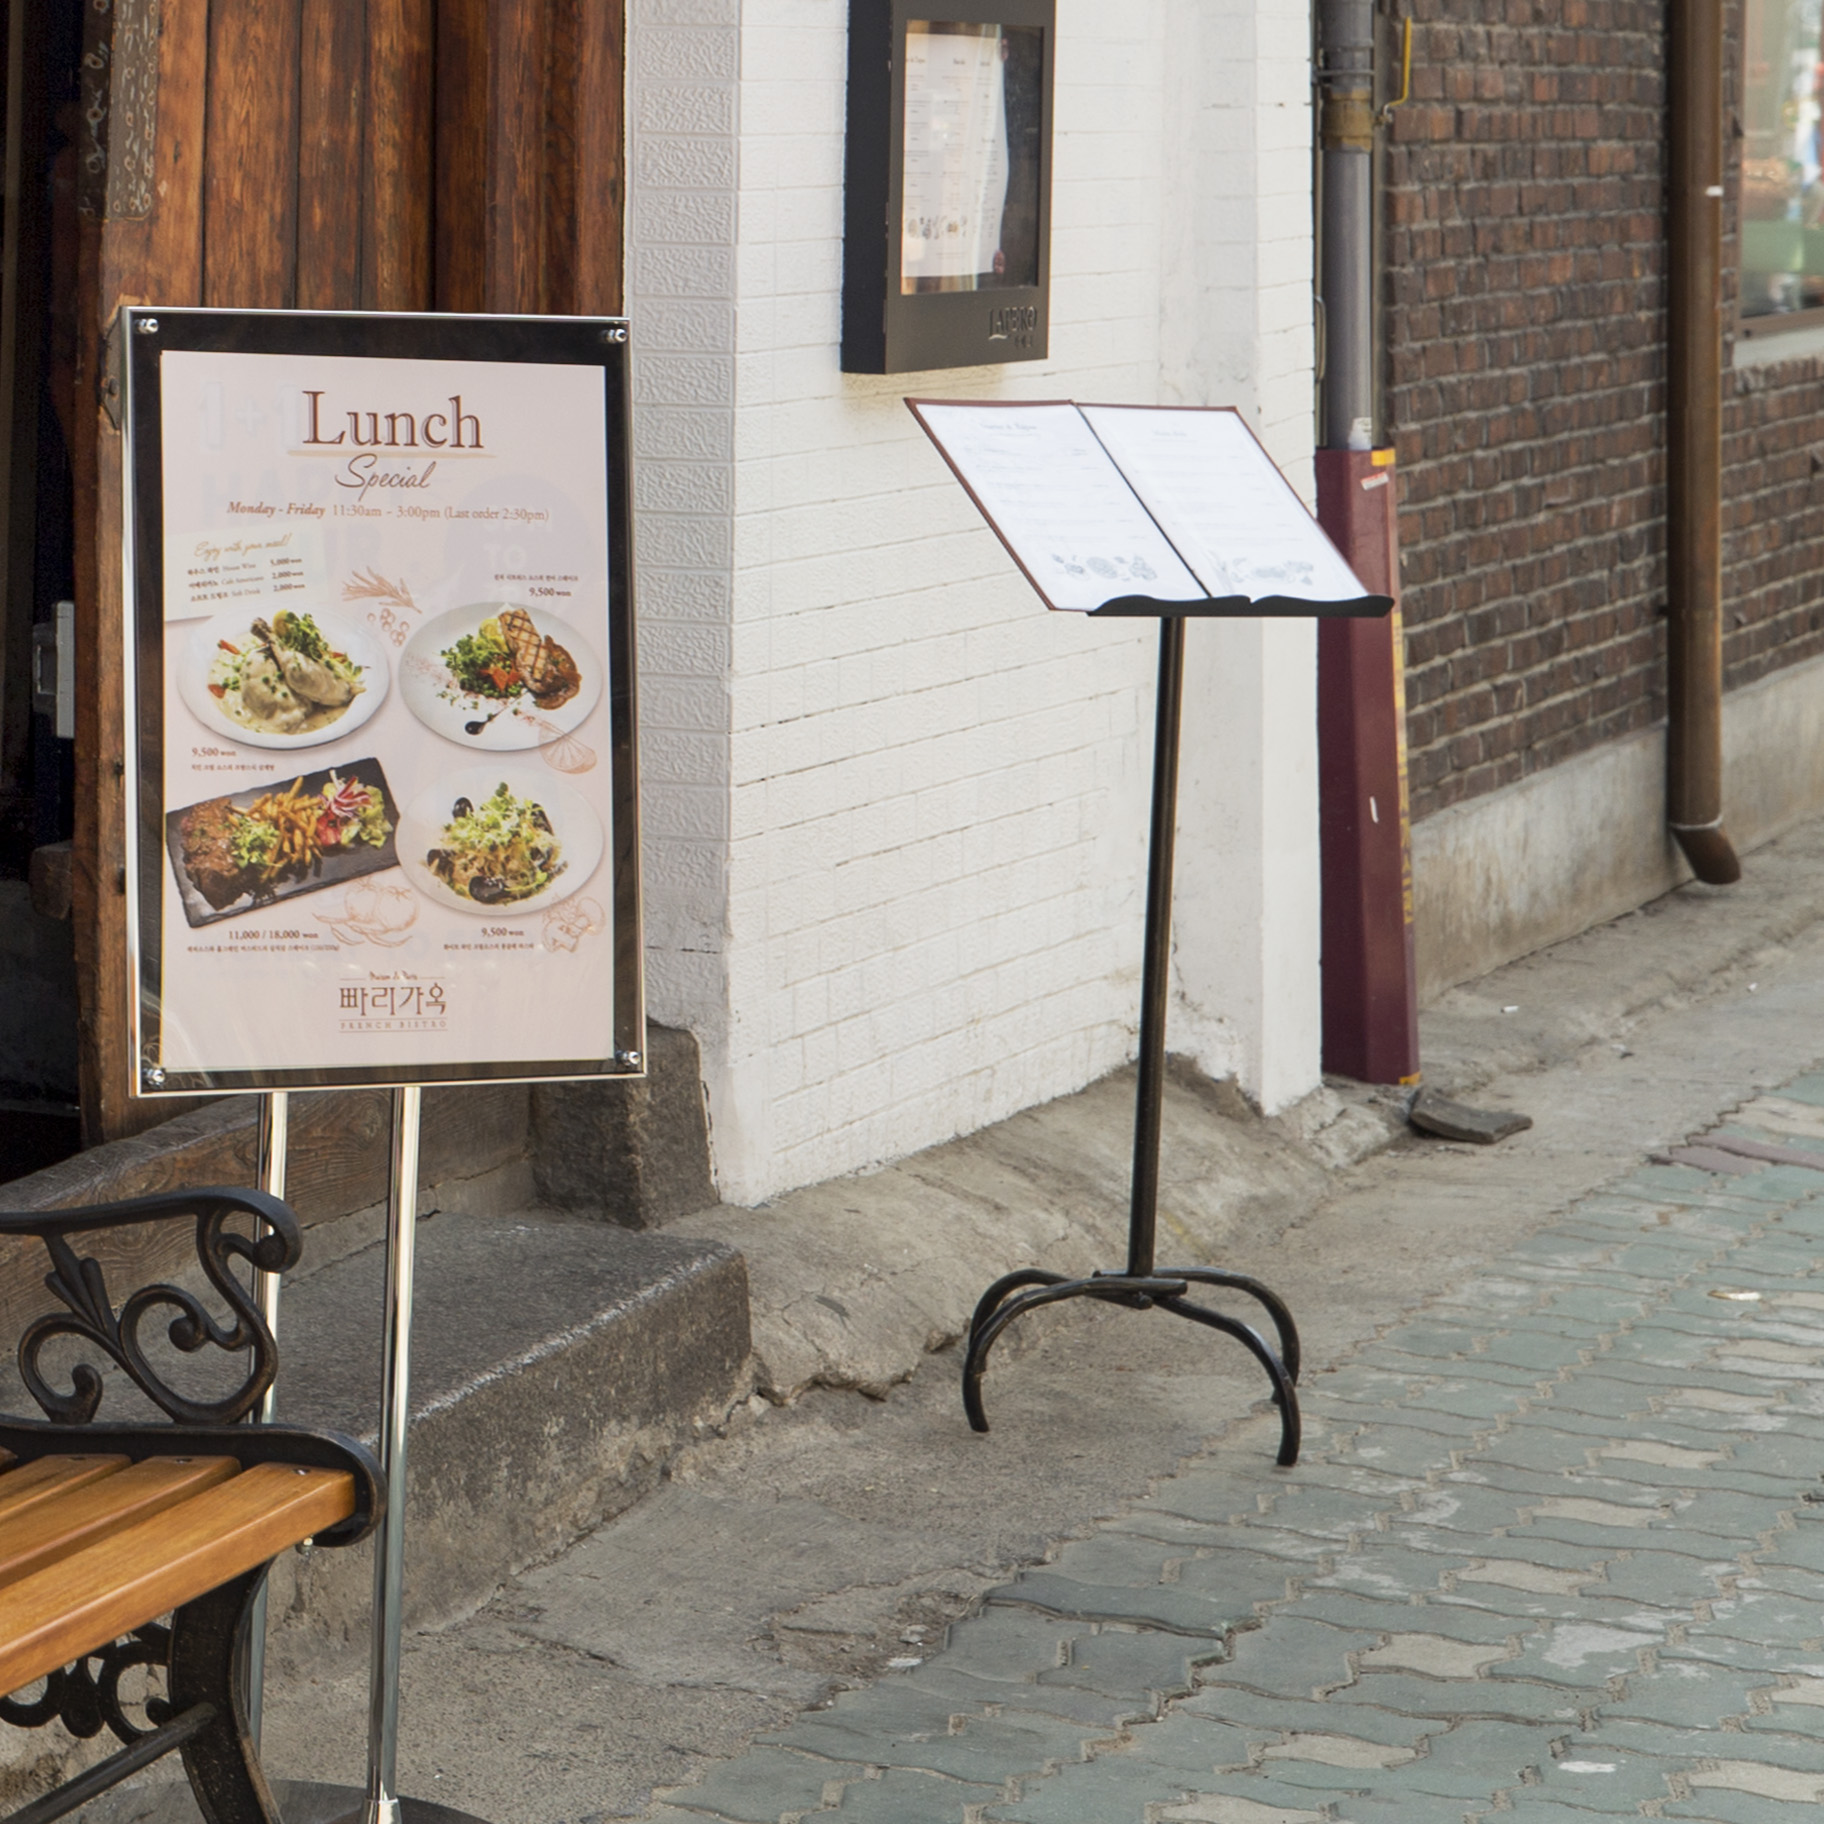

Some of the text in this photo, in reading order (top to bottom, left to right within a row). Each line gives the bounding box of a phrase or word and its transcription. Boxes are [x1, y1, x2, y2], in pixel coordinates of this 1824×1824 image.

[302, 390, 485, 449] Lunch
[334, 453, 437, 502] Special
[227, 501, 276, 517] Monday
[286, 502, 326, 519] Friday
[332, 504, 382, 518] 11:30am
[397, 504, 440, 521] 3:00pm
[444, 506, 470, 521] (Last
[472, 507, 500, 519] order
[502, 507, 550, 524] 2:30pm)
[528, 587, 555, 597] 9,500
[191, 747, 219, 757] 9,500
[228, 930, 260, 940] 11,000
[269, 929, 300, 940] 18,000
[481, 927, 507, 937] 9,500
[339, 982, 447, 1016] 빠리가옥
[340, 1020, 447, 1030] FRENCH BISTRO
